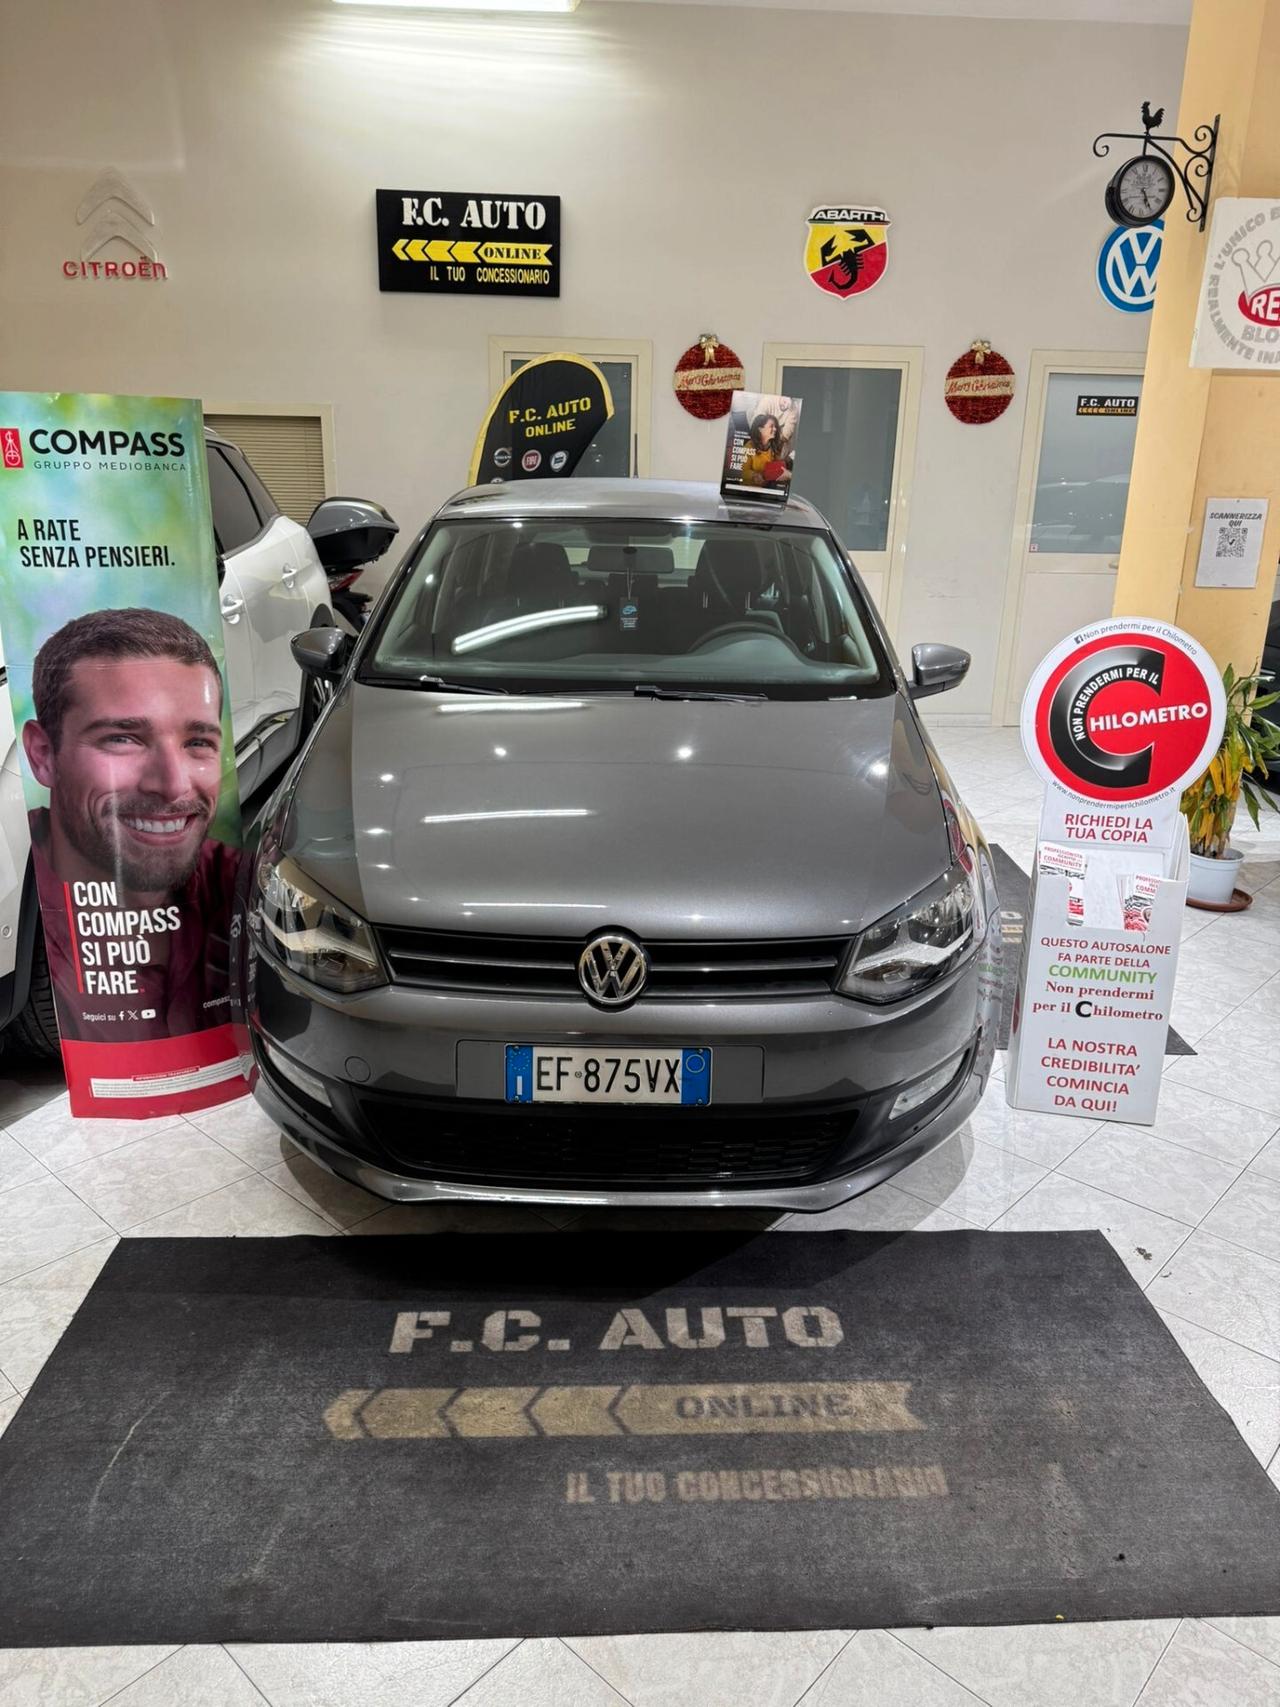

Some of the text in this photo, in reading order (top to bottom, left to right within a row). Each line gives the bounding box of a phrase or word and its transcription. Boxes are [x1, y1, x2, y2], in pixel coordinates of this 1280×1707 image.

[401, 197, 546, 230] F.C. AUTO
[814, 209, 884, 221] ABARTH
[1214, 212, 1266, 271] L'UNICO
[484, 246, 542, 260] ONLINE
[430, 265, 550, 285] IL TUO CONCESSIONARIO
[1251, 291, 1280, 322] RE
[1208, 274, 1255, 361] REALMENTE
[1241, 324, 1280, 344] BLO
[508, 397, 592, 424] F.C. AUTO
[1080, 398, 1136, 408] F.C. AUTO
[525, 419, 576, 438] ONLINE
[29, 429, 186, 457] COMPASS
[34, 461, 187, 471] GRUPPO MEDIOBANCA
[1209, 512, 1263, 520] SCANNERIZZA
[1229, 520, 1243, 528] QUI
[18, 519, 81, 541] A RATE
[20, 545, 176, 568] SENZA PENSIERI.
[1083, 622, 1197, 656] Non prendermi per il Chilometro
[1072, 667, 1160, 741] NON PRENDERMI PER IL
[1052, 779, 1176, 810] www.nonprendermiperilchilometro.it
[1064, 813, 1153, 830] RICHIEDI LA
[1066, 827, 1148, 844] TUA COPIA
[73, 881, 118, 906] CON
[1135, 884, 1157, 893] COMM
[77, 906, 182, 937] COMPASS
[81, 935, 151, 966] SI PUÒ
[1040, 937, 1171, 955] QUESTO AUTOSALONE
[1057, 952, 1150, 968] FA PARTE DELLA
[1049, 964, 1158, 984] COMMUNITY
[1045, 980, 1154, 1001] Non prendermi
[82, 1011, 107, 1023] Seguici
[1032, 1000, 1164, 1021] per il Chilometro
[1048, 1037, 1138, 1057] LA NOSTRA
[1046, 1075, 1130, 1095] COMINCIA
[1054, 1094, 1118, 1112] DA QUI!
[388, 1305, 846, 1354] F.C. AUTO
[676, 1391, 852, 1422] ONLINE
[565, 1471, 595, 1502] IL
[607, 1470, 666, 1502] TUO
